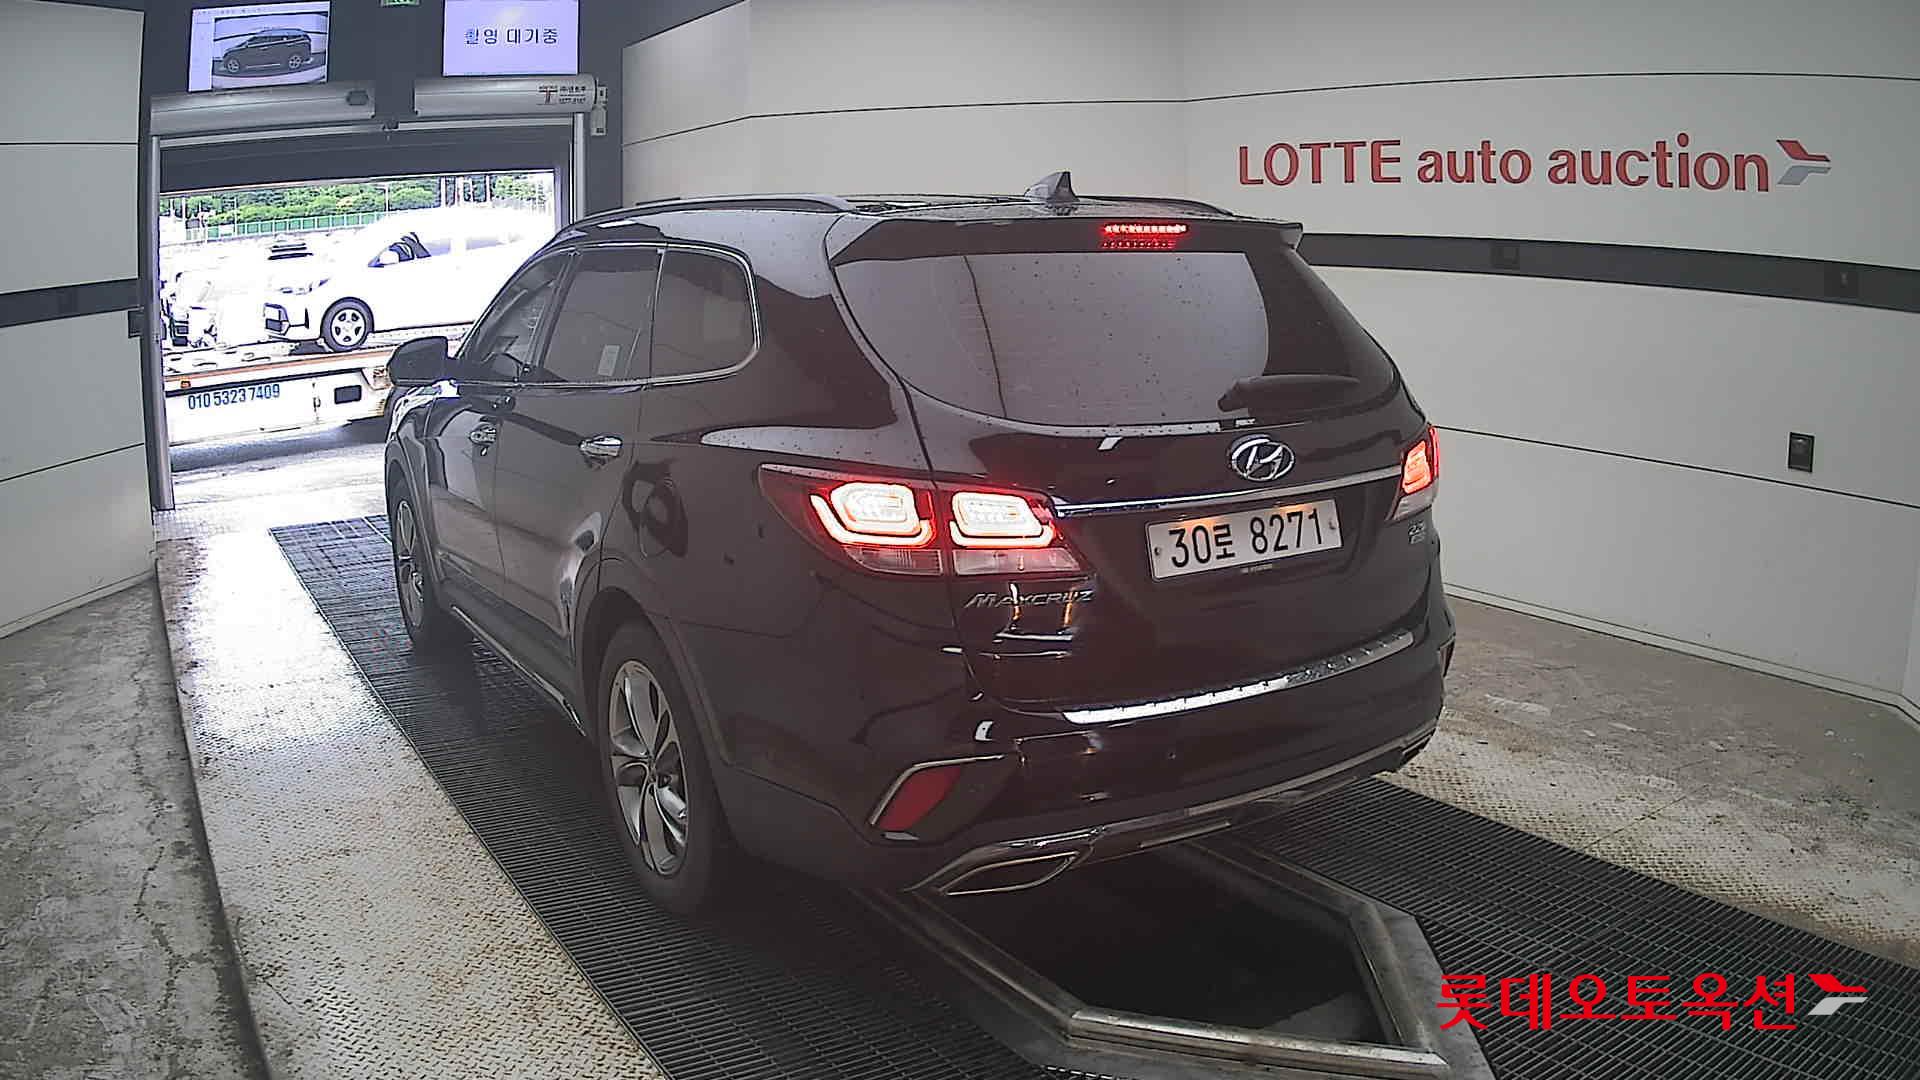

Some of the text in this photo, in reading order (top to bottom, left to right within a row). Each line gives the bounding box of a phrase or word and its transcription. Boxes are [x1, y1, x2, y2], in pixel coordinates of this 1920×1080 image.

[506, 28, 559, 44] 대기중
[1238, 132, 1770, 192] LOTTE auto auction
[188, 384, 280, 409] 010 5323 7409
[1167, 507, 1323, 568] 30로 8271
